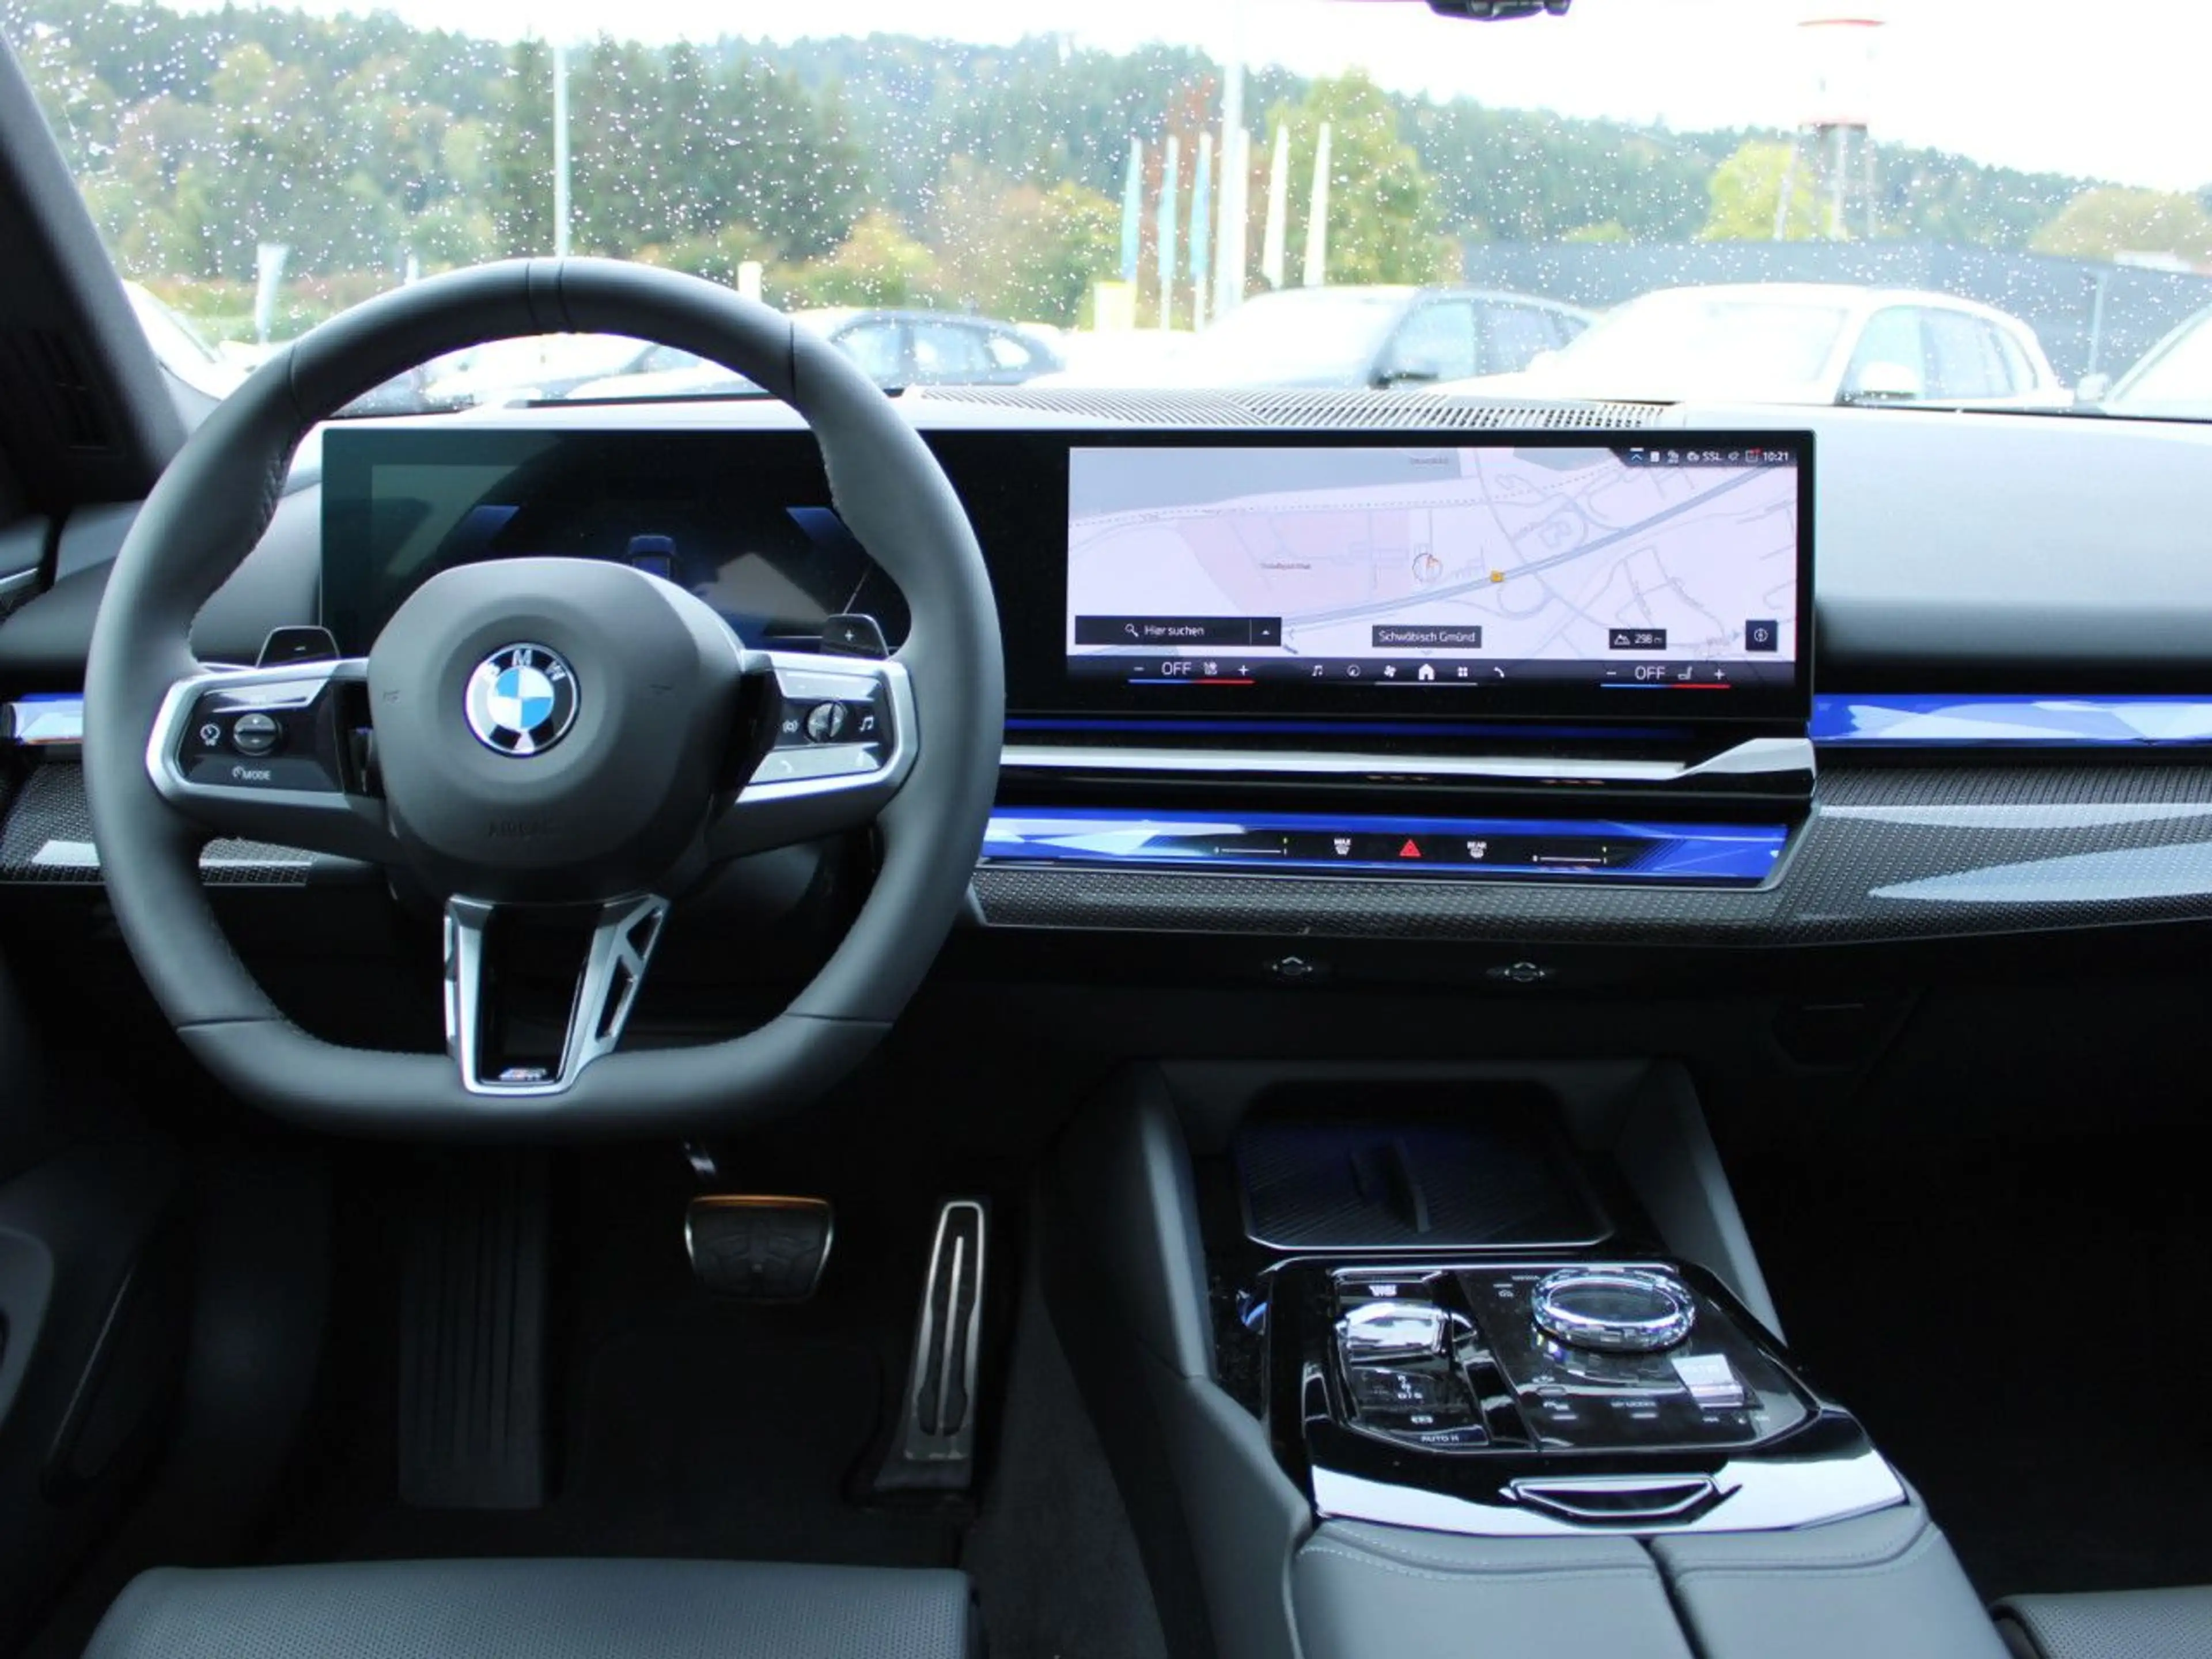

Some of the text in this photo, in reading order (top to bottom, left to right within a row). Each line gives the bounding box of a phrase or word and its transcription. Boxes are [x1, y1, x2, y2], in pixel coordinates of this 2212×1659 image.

[1702, 451, 1723, 461] SSL
[1763, 451, 1789, 461] 10:21
[1144, 625, 1205, 636] Hier suchen
[1378, 630, 1475, 642] Schwäbisch Gmünd
[1634, 634, 1653, 644] 298
[482, 649, 567, 682] BMW
[1161, 661, 1192, 675] OFF
[1634, 665, 1665, 680] OFF
[245, 770, 271, 781] MODE
